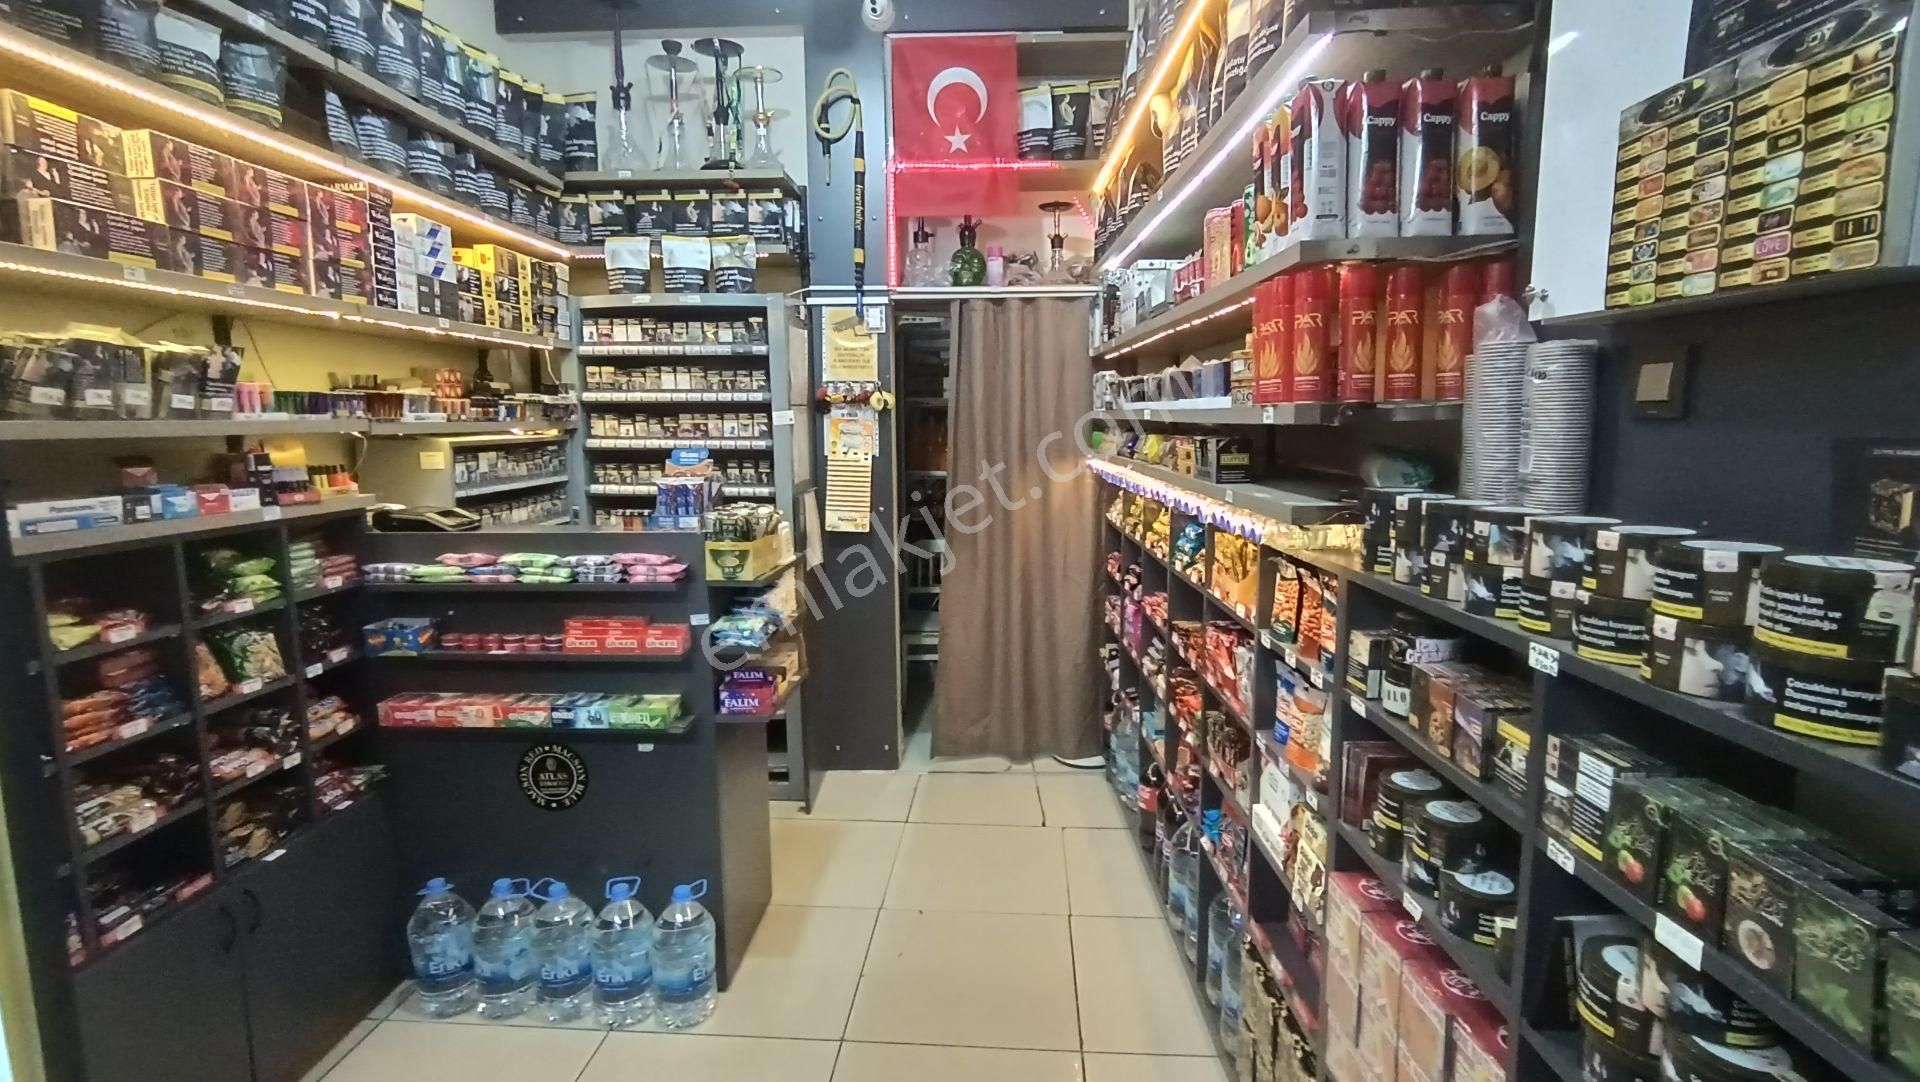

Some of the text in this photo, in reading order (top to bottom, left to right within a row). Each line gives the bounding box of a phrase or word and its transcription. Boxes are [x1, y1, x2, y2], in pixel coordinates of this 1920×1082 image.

[1367, 115, 1396, 127] Cappy
[1423, 112, 1452, 125] Cappy
[1480, 111, 1511, 122] Cappy
[1295, 312, 1323, 329] PAR
[1388, 309, 1419, 326] PAR
[733, 671, 764, 680] FALIM
[725, 698, 760, 708] FALIM
